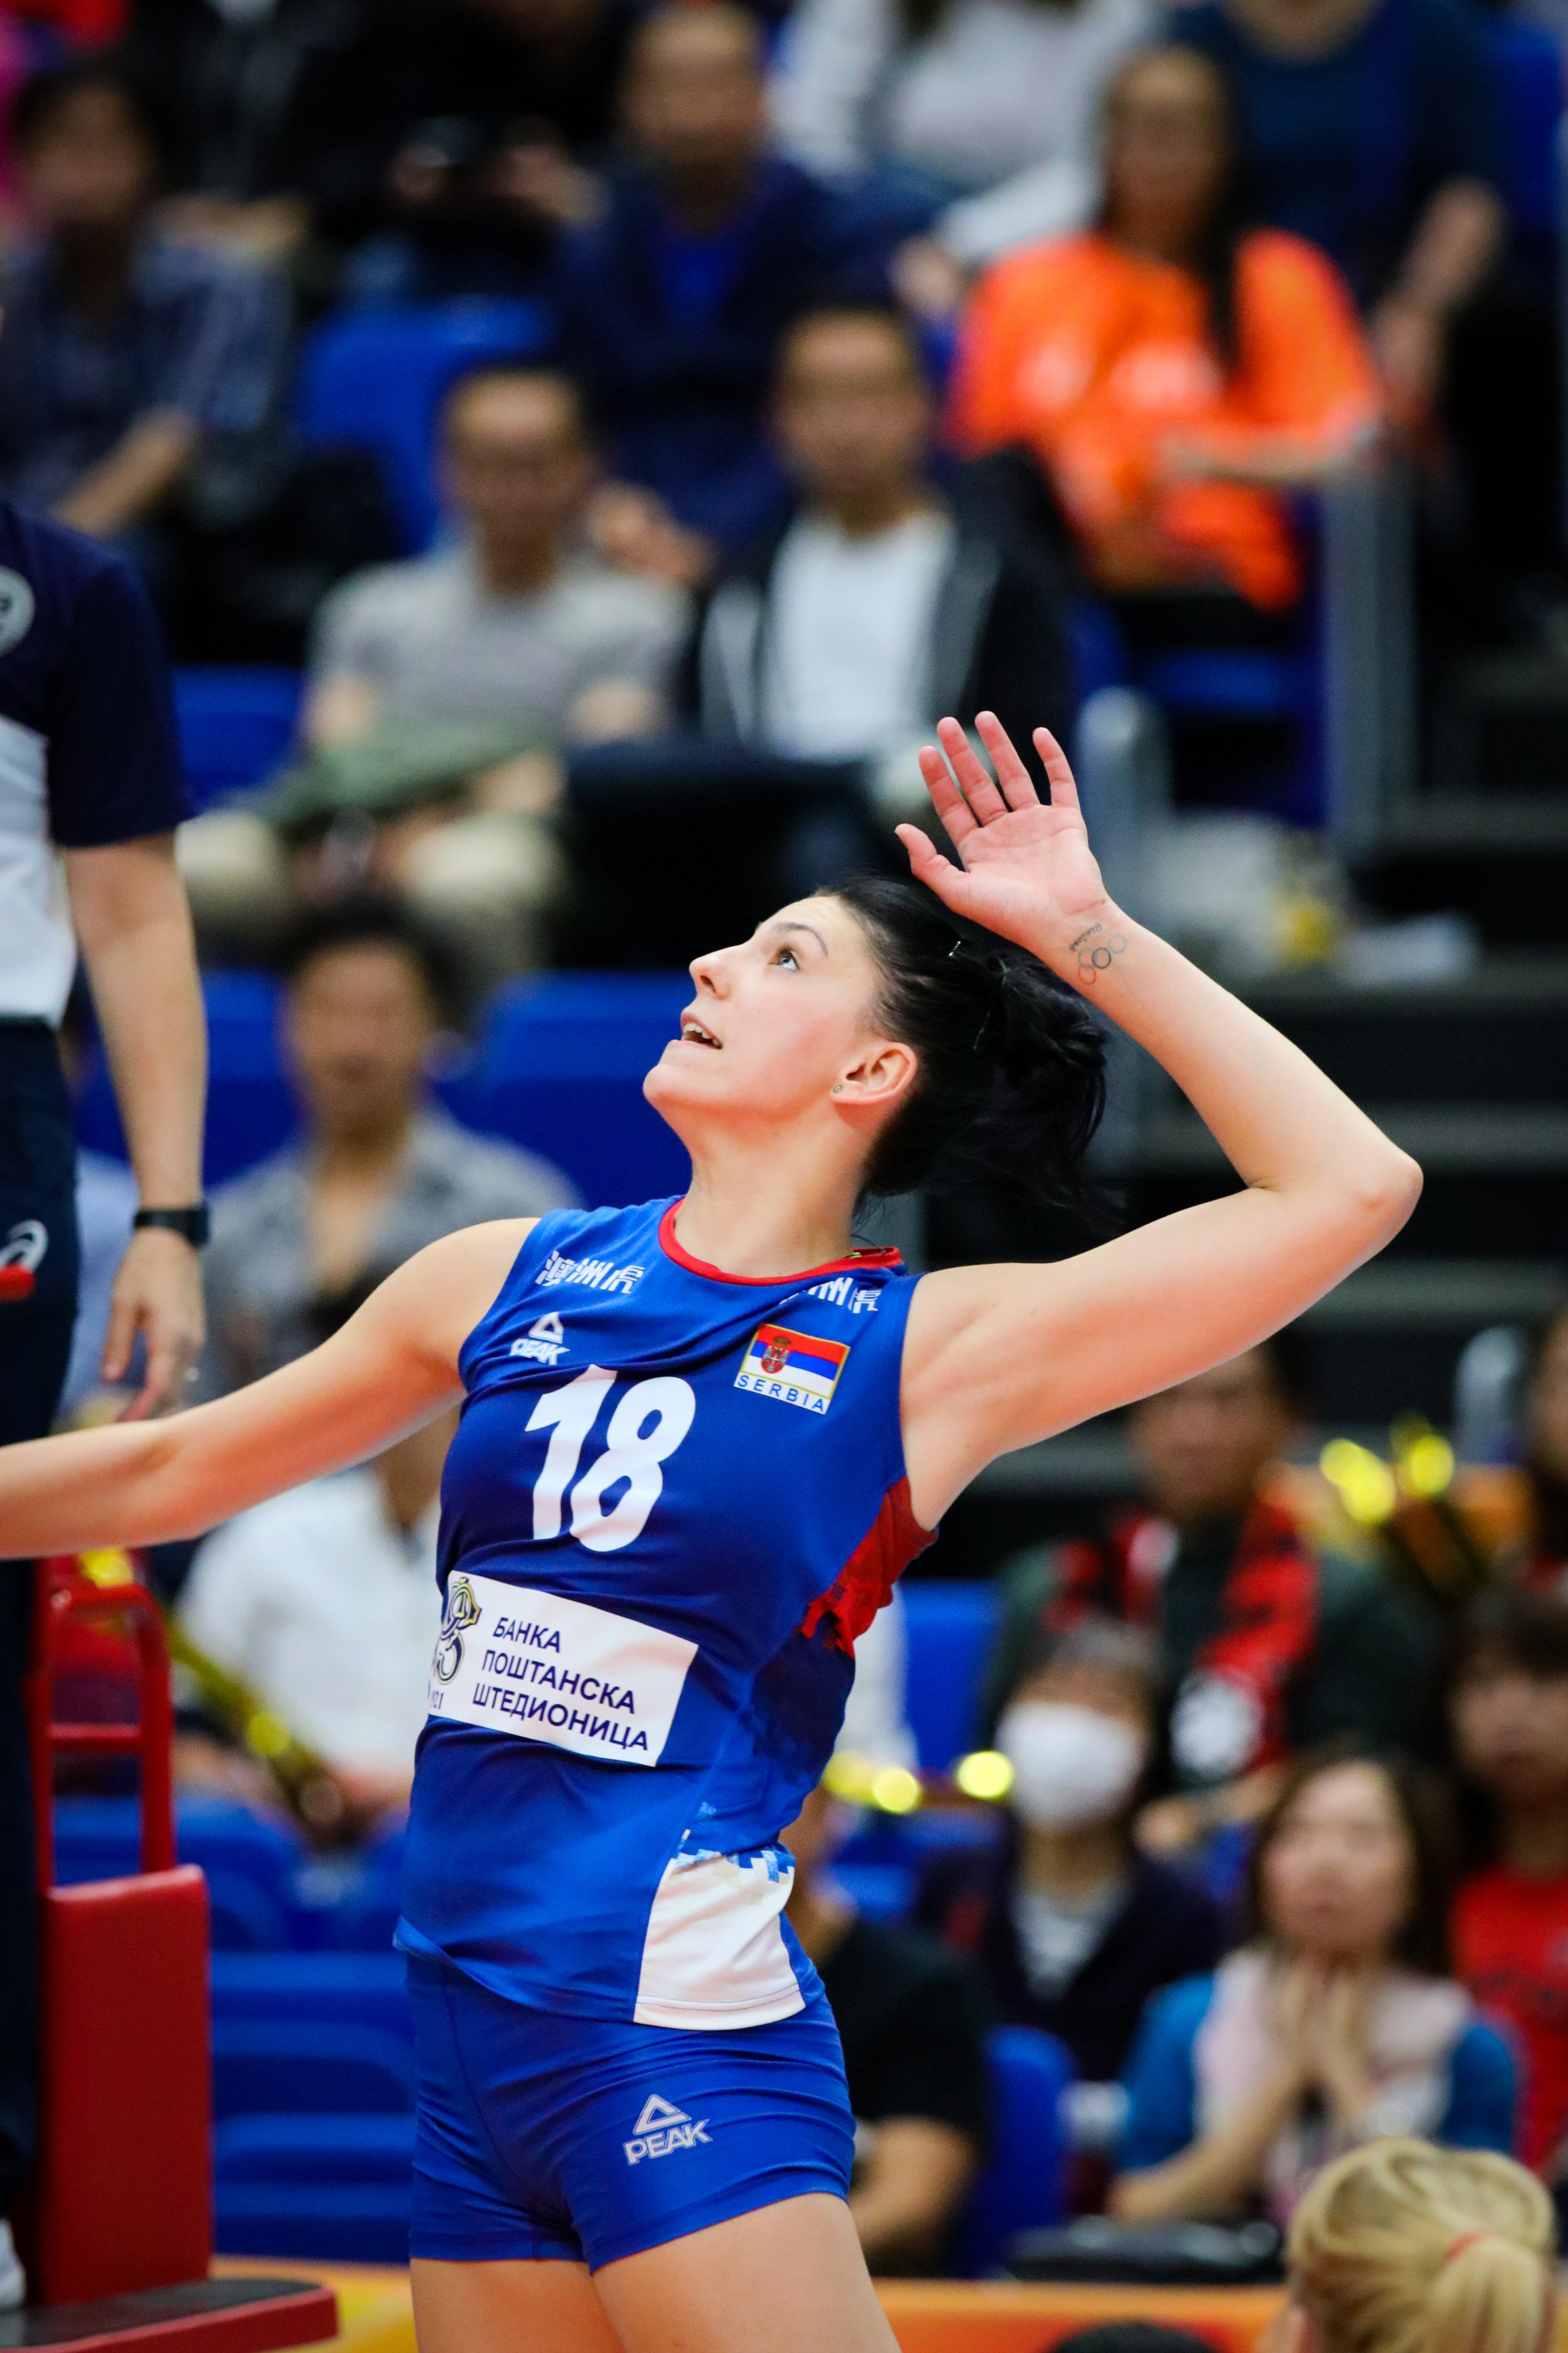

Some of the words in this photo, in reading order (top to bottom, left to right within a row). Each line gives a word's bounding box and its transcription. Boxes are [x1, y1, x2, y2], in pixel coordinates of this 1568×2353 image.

[509, 1338, 570, 1365] PEAK
[737, 1375, 824, 1412] SERBIA
[524, 1364, 696, 1552] 18
[493, 1617, 562, 1653] БАНКА
[481, 1649, 635, 1714] ПОШТАНСКА
[473, 1683, 648, 1751] ШТЕДИОНИЦА
[622, 2119, 713, 2166] PEAK
